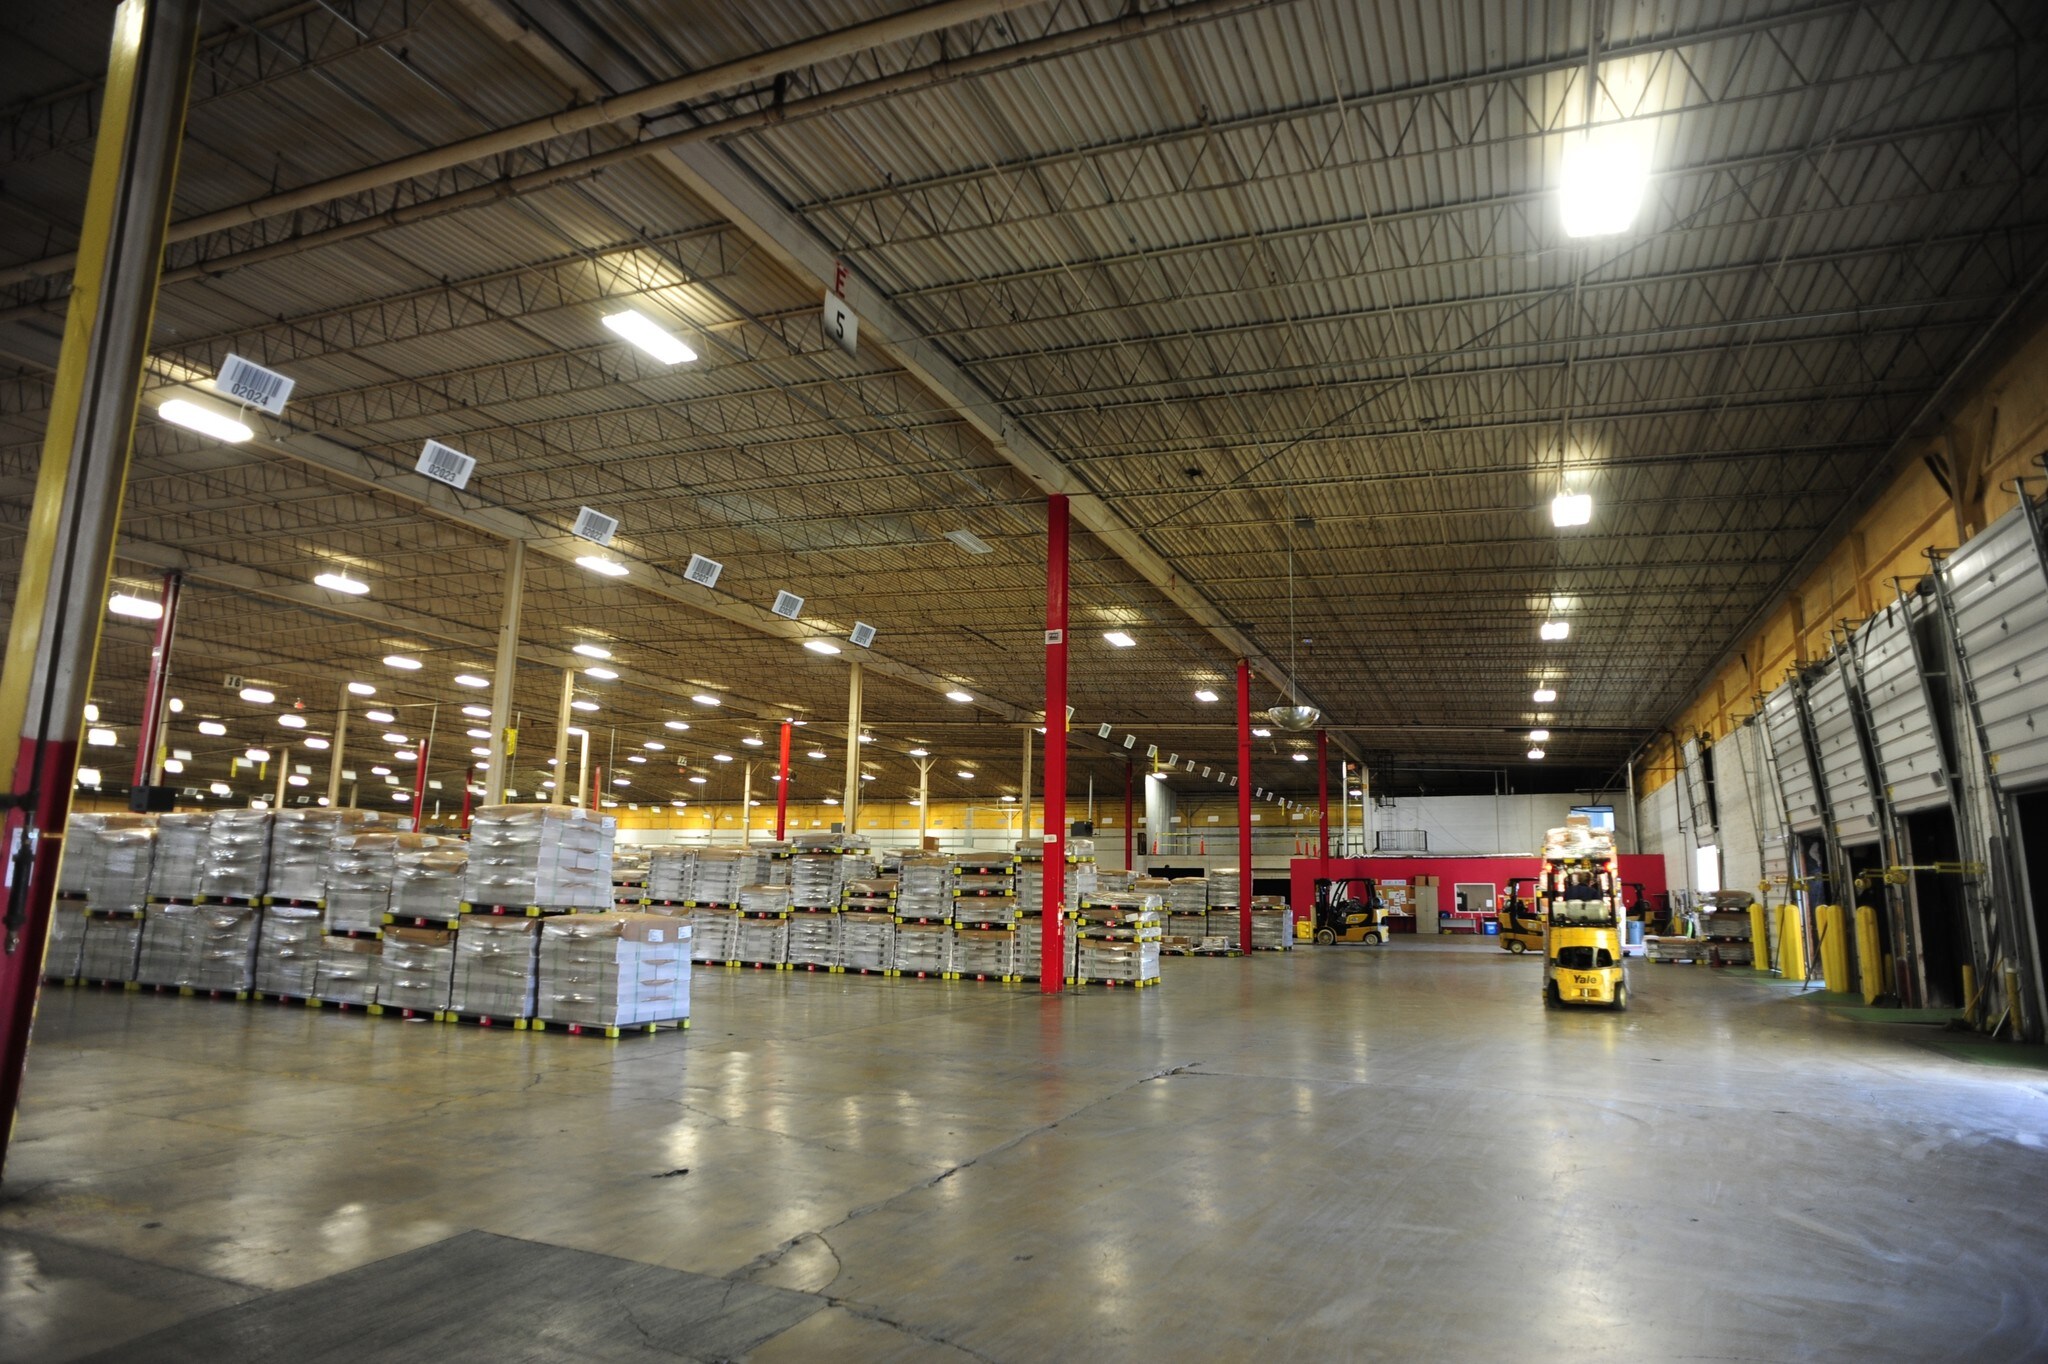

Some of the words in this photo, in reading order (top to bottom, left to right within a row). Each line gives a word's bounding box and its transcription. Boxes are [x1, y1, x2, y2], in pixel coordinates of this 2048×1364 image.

[836, 310, 846, 339] 5
[231, 383, 269, 406] 02024
[428, 463, 456, 482] 02023
[581, 525, 603, 541] 02022
[1573, 974, 1597, 984] Yale
